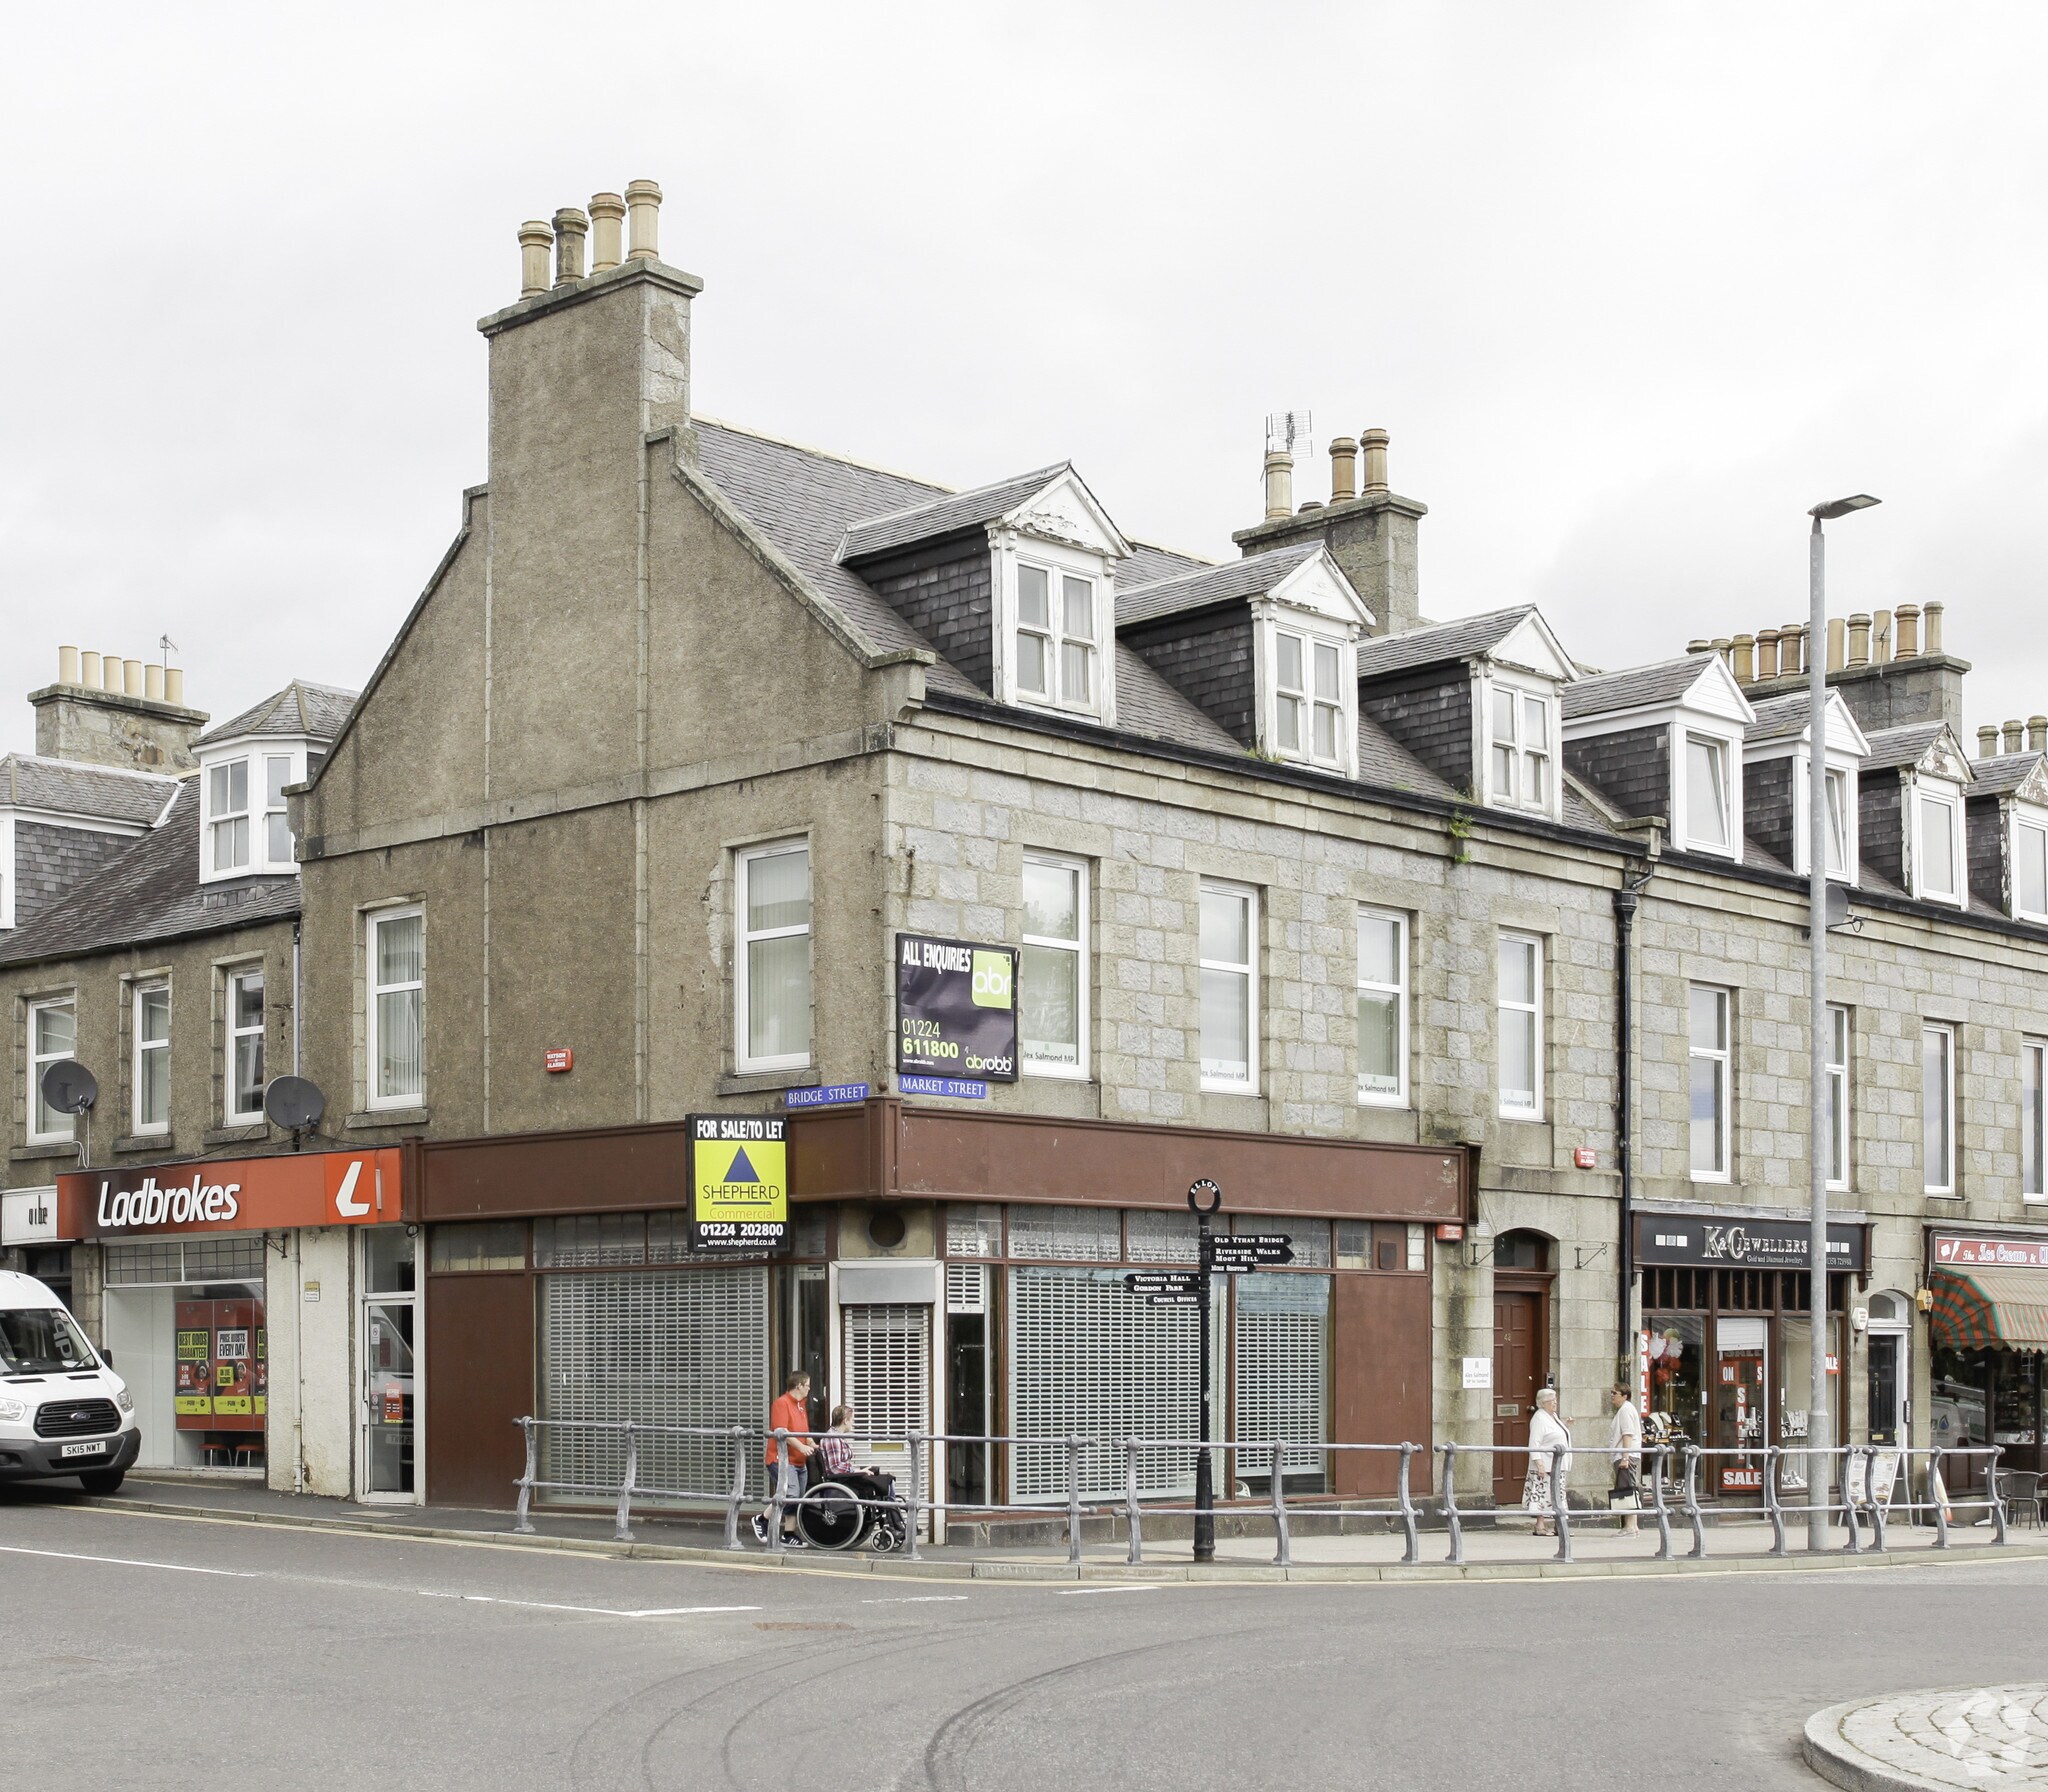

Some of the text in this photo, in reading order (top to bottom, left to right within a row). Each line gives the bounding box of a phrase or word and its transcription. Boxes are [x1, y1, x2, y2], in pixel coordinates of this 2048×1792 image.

[902, 940, 971, 974] ALL ENQUIRIES
[902, 1018, 941, 1038] 01224
[902, 1037, 959, 1059] 611800
[965, 1053, 1012, 1072] abrobb
[1035, 1051, 1063, 1062] Salmond
[1064, 1055, 1075, 1063] MP
[901, 1077, 984, 1096] MARKET STREET
[787, 1085, 866, 1105] BRIDGE STREET
[696, 1120, 783, 1139] FOR SALE/TO LET
[702, 1184, 780, 1200] SHEPHERD
[1190, 1179, 1219, 1194] ELLON
[97, 1174, 241, 1227] Ladbrokes
[709, 1207, 775, 1219] Commercial
[700, 1223, 784, 1237] 01224 202800
[707, 1238, 777, 1247] www.shepherd.co.uk
[1214, 1236, 1285, 1244] OLD YTHAN BRIDGE
[1215, 1247, 1281, 1255] RIVERSIDE WALKS
[1996, 1243, 2028, 1263] Cream
[1215, 1255, 1237, 1263] MOOT
[1134, 1275, 1191, 1283] VICTORIA HALL
[1133, 1284, 1184, 1292] GORDON PARK
[1176, 1295, 1198, 1303] OFFICES
[219, 1343, 234, 1357] EVERY
[235, 1343, 246, 1356] DAY
[1826, 1356, 1838, 1370] ALE
[1640, 1333, 1649, 1413] SALE
[1722, 1366, 1734, 1382] ON
[66, 1443, 101, 1455] SK15 NWT
[1723, 1471, 1762, 1486] SALE
